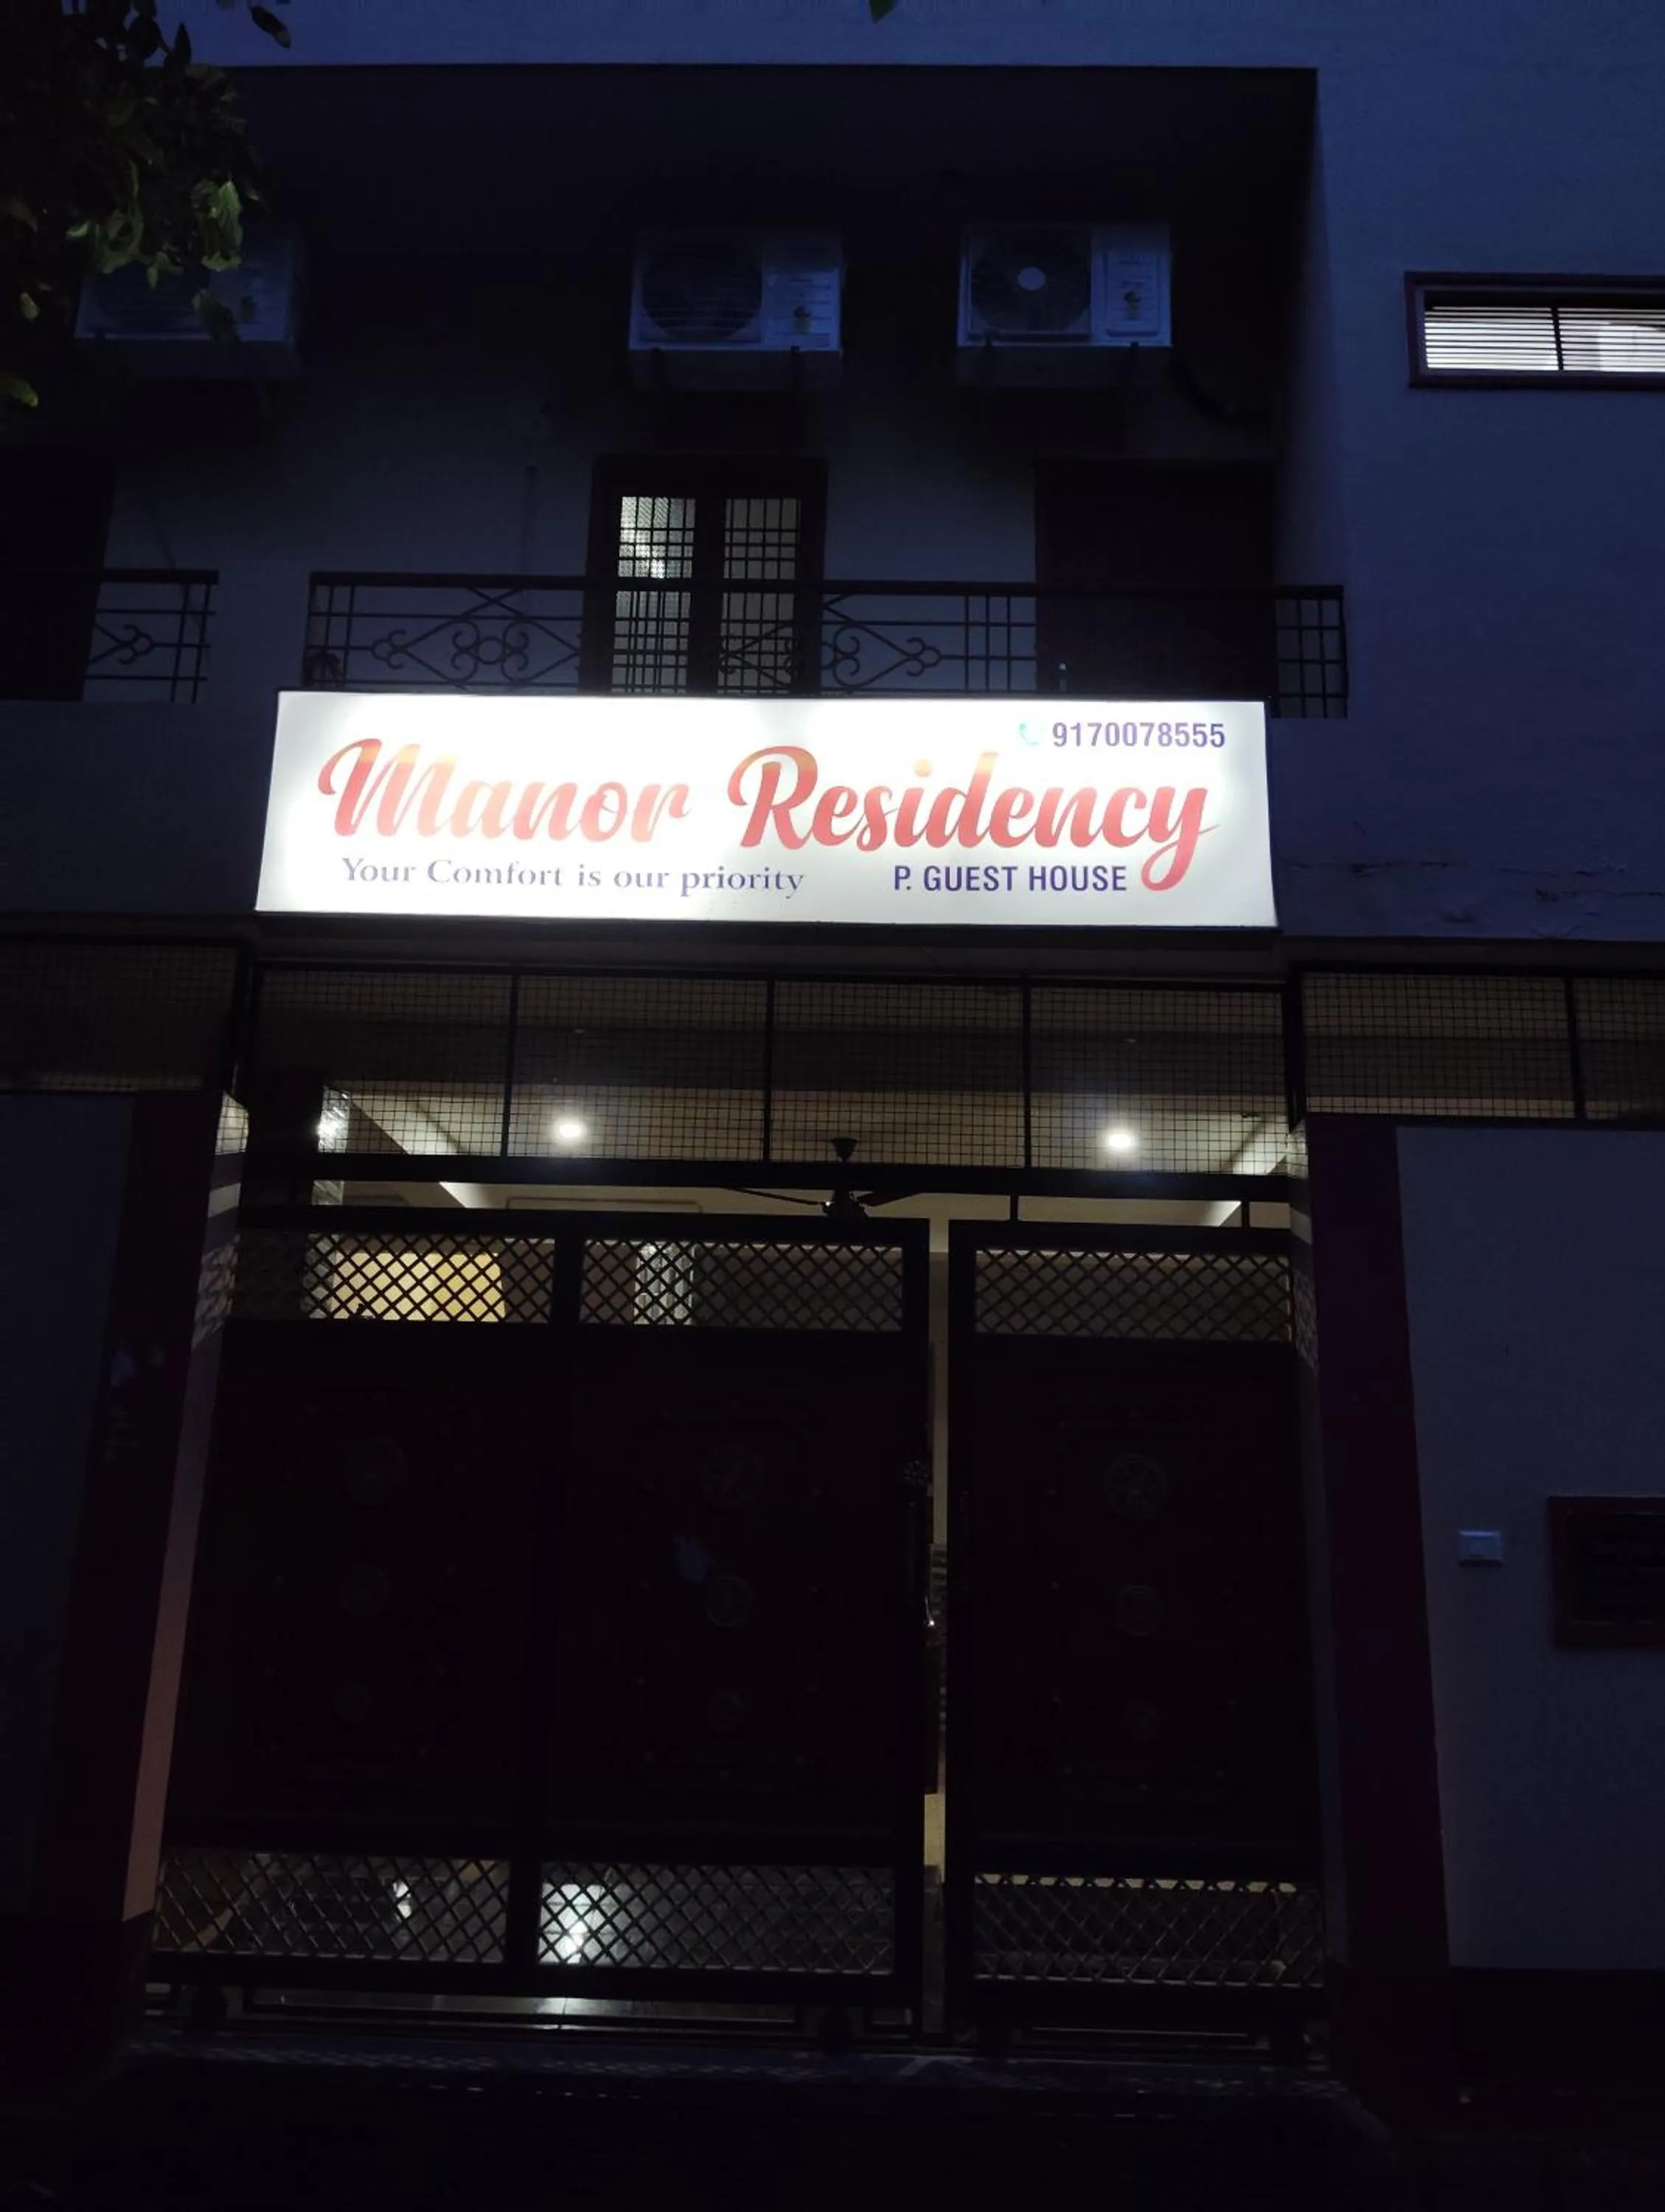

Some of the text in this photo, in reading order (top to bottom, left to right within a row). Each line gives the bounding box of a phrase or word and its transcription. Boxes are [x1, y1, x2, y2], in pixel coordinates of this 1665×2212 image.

[1052, 721, 1226, 748] 9170078555
[317, 737, 1218, 892] Manor Residency
[341, 857, 804, 898] Your Comfort is our priority
[893, 865, 1128, 893] P. GUEST HOUSE
